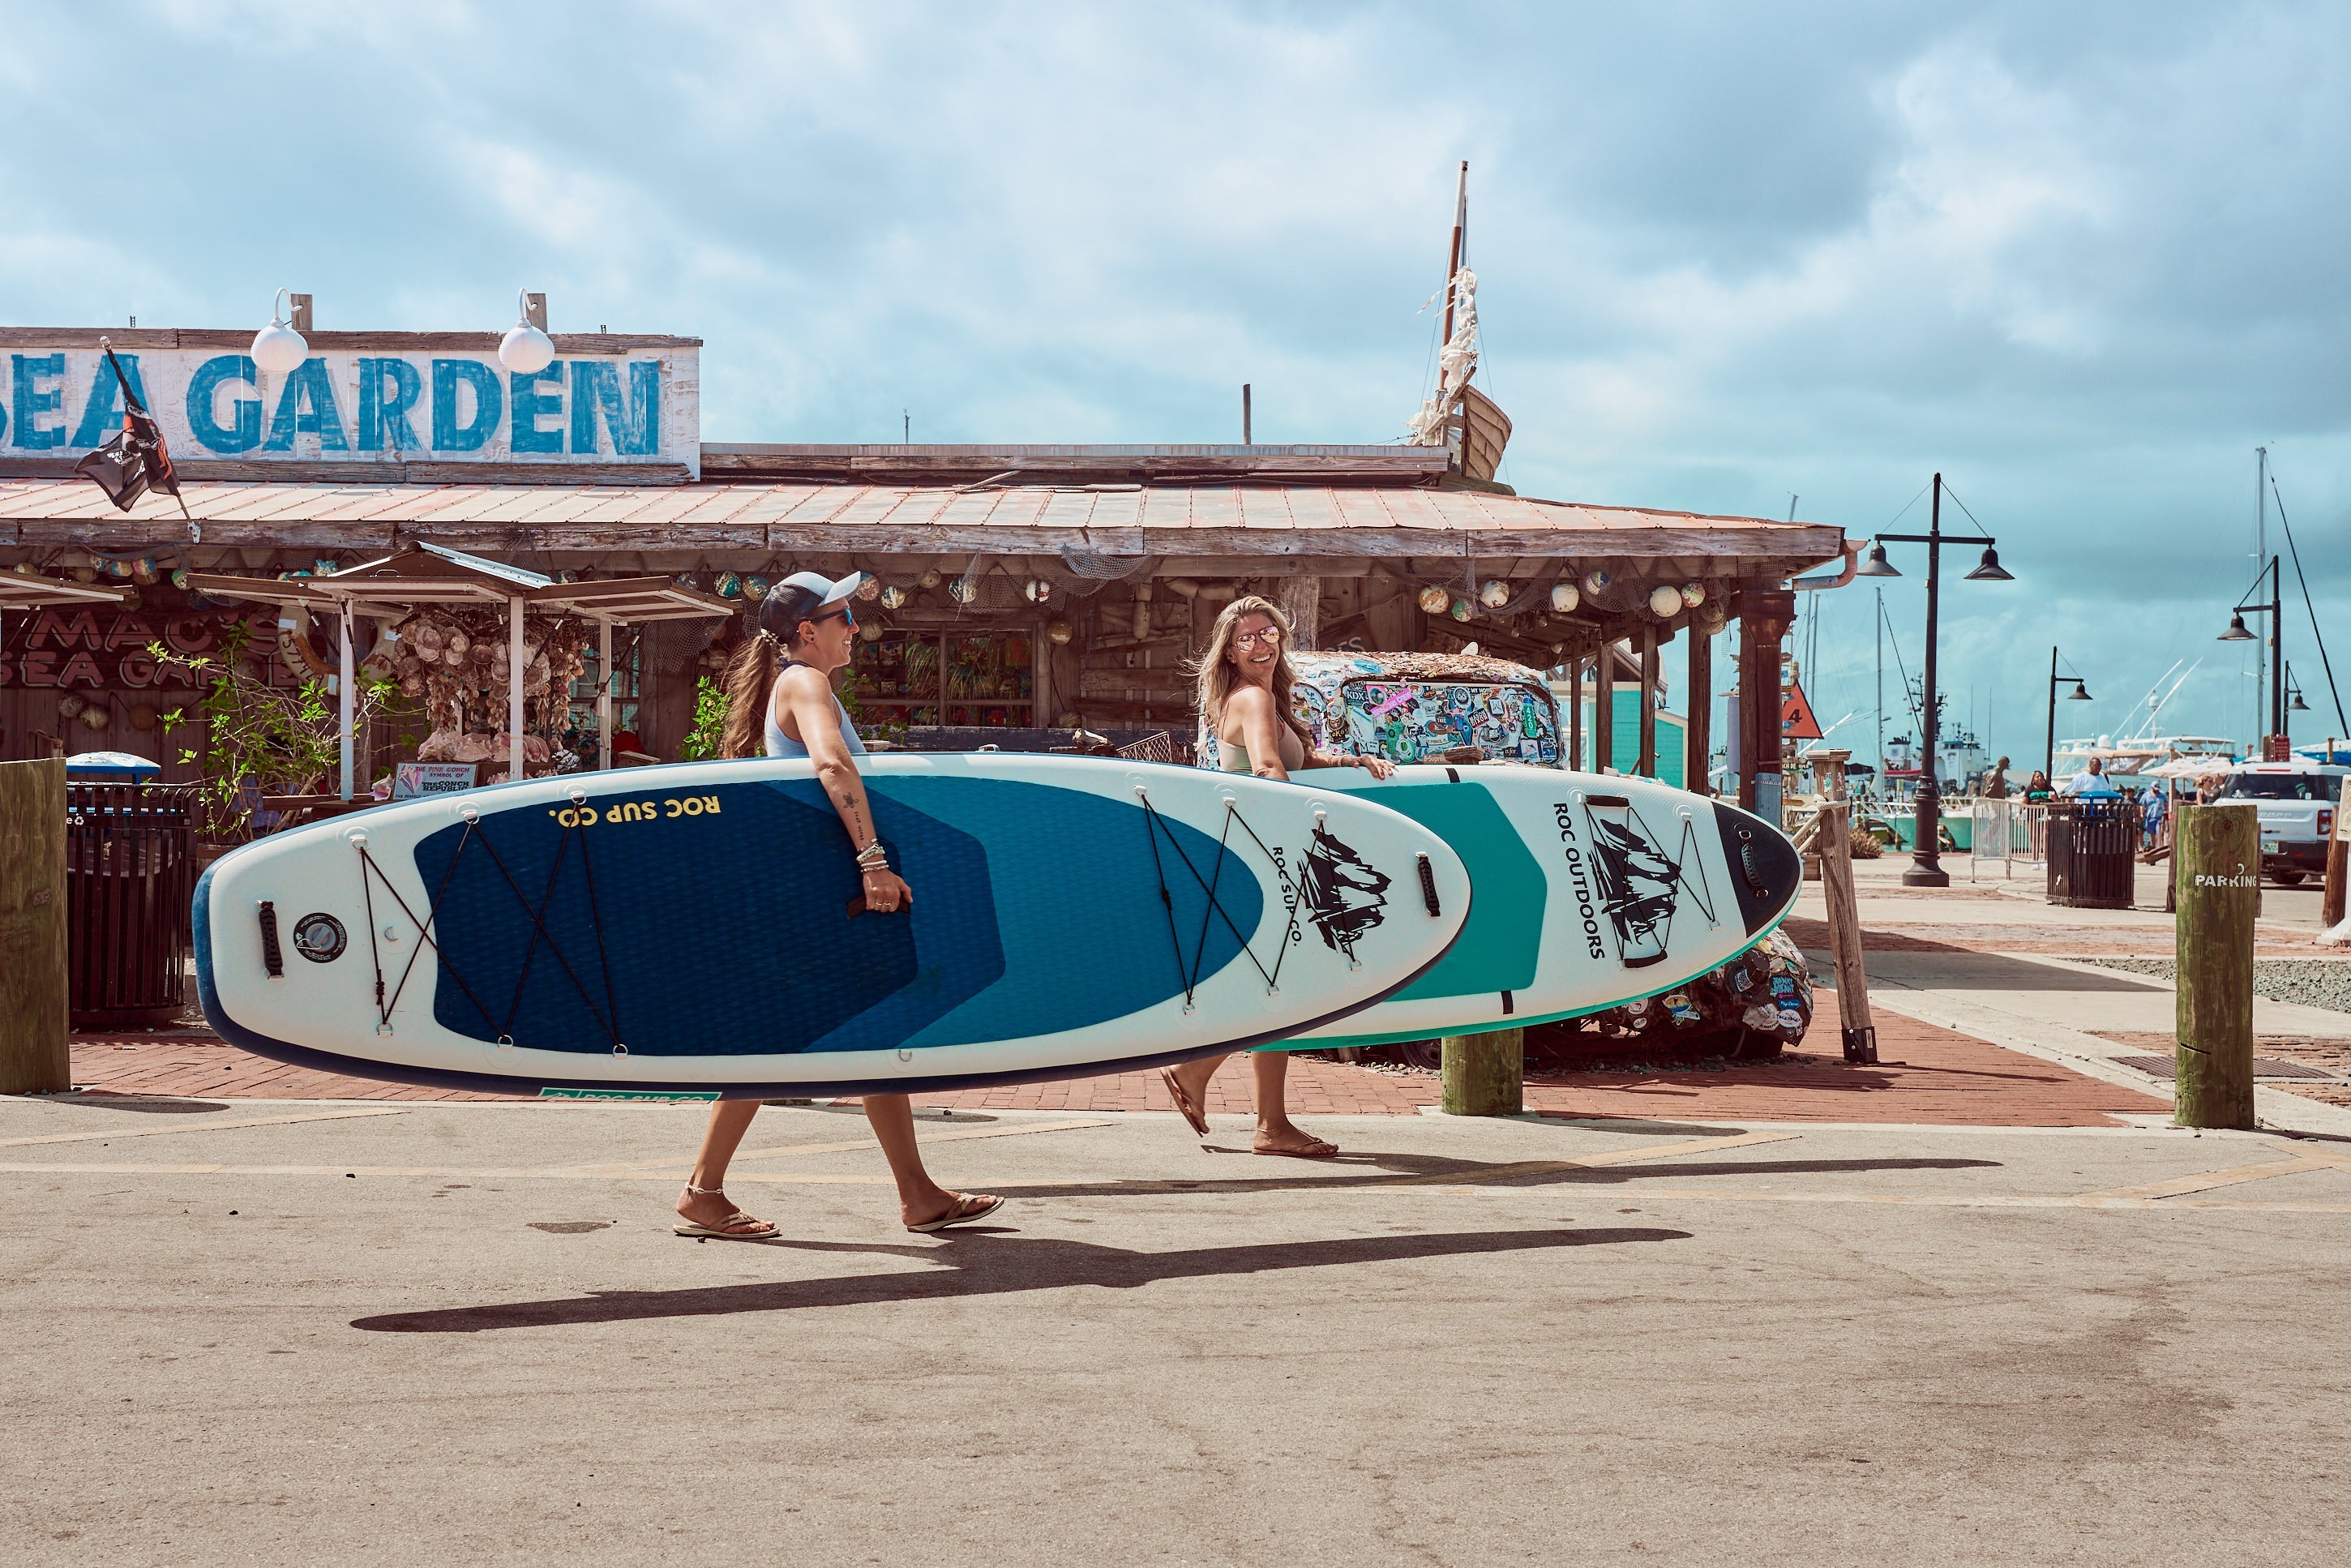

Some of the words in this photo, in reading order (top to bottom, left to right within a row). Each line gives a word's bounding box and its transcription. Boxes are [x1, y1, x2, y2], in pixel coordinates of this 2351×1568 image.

[0, 353, 152, 451] EA
[186, 354, 659, 456] GARDEN
[1788, 709, 1803, 723] 4
[548, 807, 598, 828] CO.
[606, 801, 657, 823] SUP
[663, 795, 721, 818] ROC
[1553, 803, 1576, 842] ROC
[1565, 847, 1605, 960] OUTDOORS
[2195, 874, 2257, 888] PARKING
[1272, 846, 1288, 880] ROC
[1281, 885, 1296, 915] SUP
[1289, 919, 1302, 947] CO.
